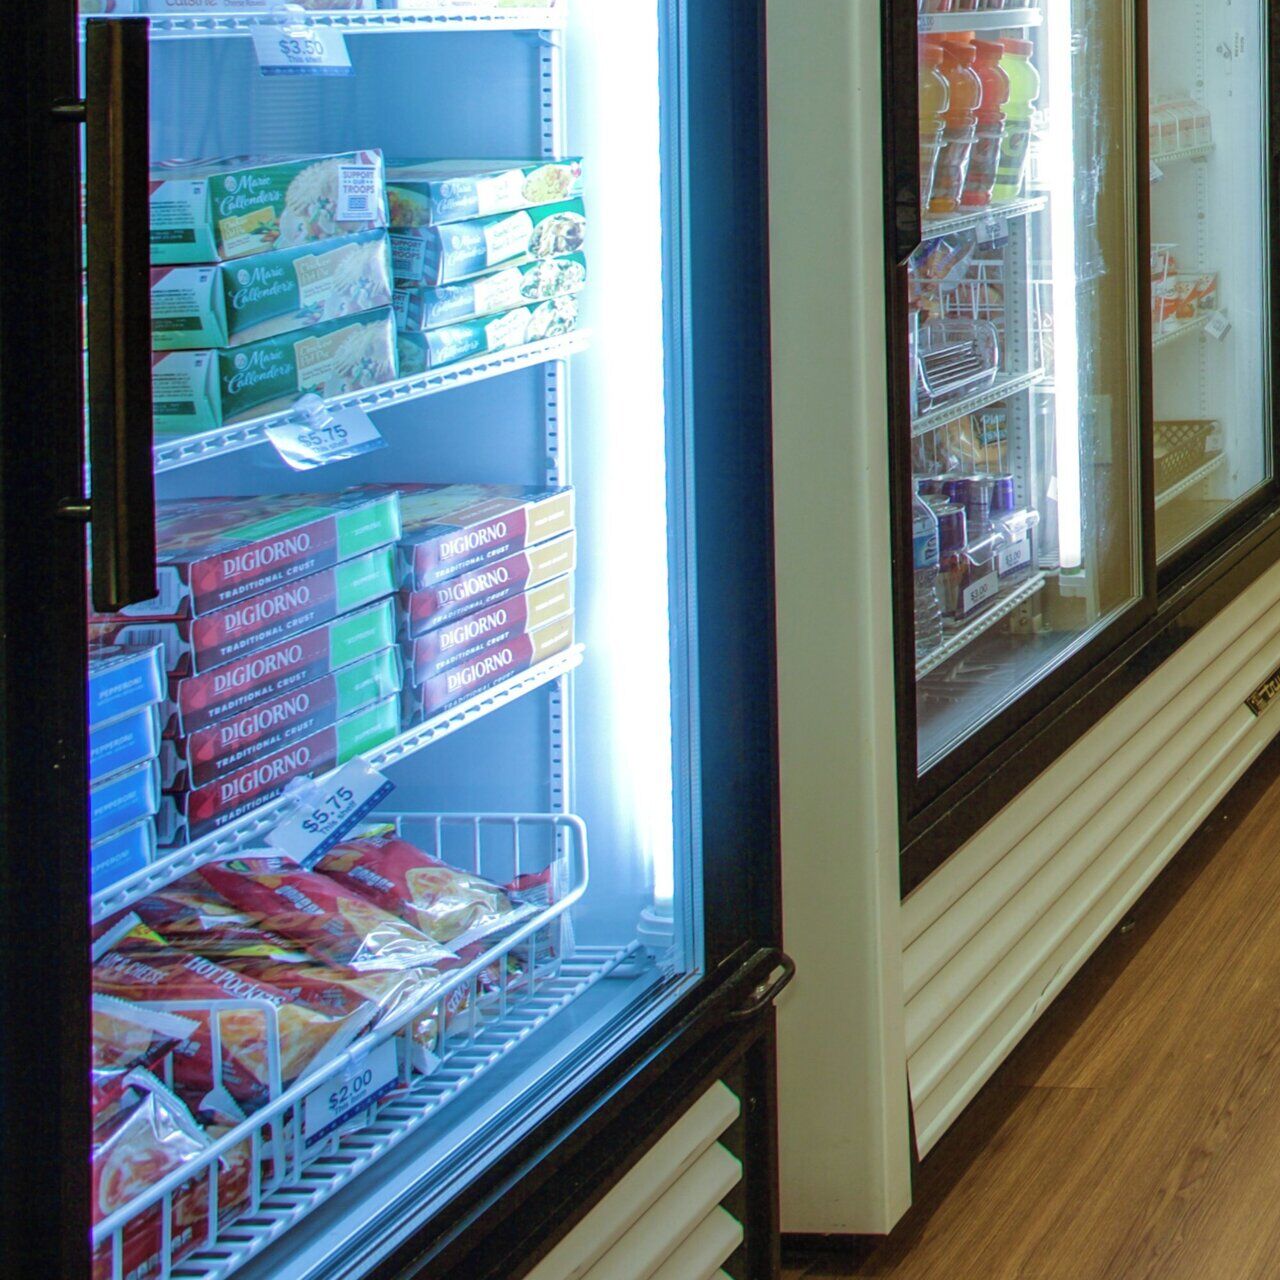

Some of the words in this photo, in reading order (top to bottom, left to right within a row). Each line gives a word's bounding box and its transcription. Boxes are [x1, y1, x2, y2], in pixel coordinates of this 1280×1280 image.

[278, 38, 324, 56] $3.50
[342, 170, 375, 180] SUPPORT
[342, 184, 375, 195] TROOPS
[223, 532, 311, 580] DIGIORNO
[440, 520, 507, 560] DIGIORNO
[218, 574, 284, 601] TRADITIONAL
[286, 559, 316, 576] CRUST
[437, 566, 509, 607] DIGIORNO
[224, 585, 311, 634] DIGIORNO
[440, 608, 507, 651] DIGIORNO
[220, 626, 284, 656] TRADITIONAL
[286, 612, 316, 627] CRUST
[213, 644, 303, 693] DIGIORNO
[447, 648, 513, 692] DIGIORNO
[208, 684, 274, 717] TRADITIONAL
[276, 670, 308, 689] CRUST
[220, 693, 310, 749] DIGIORNO
[215, 733, 283, 769] TRADITIONAL
[284, 718, 315, 737] CRUST
[220, 746, 310, 804] DIGIORNO
[302, 786, 354, 834] $5.75
[184, 955, 221, 981] HOT
[328, 1068, 373, 1109] $2.00
